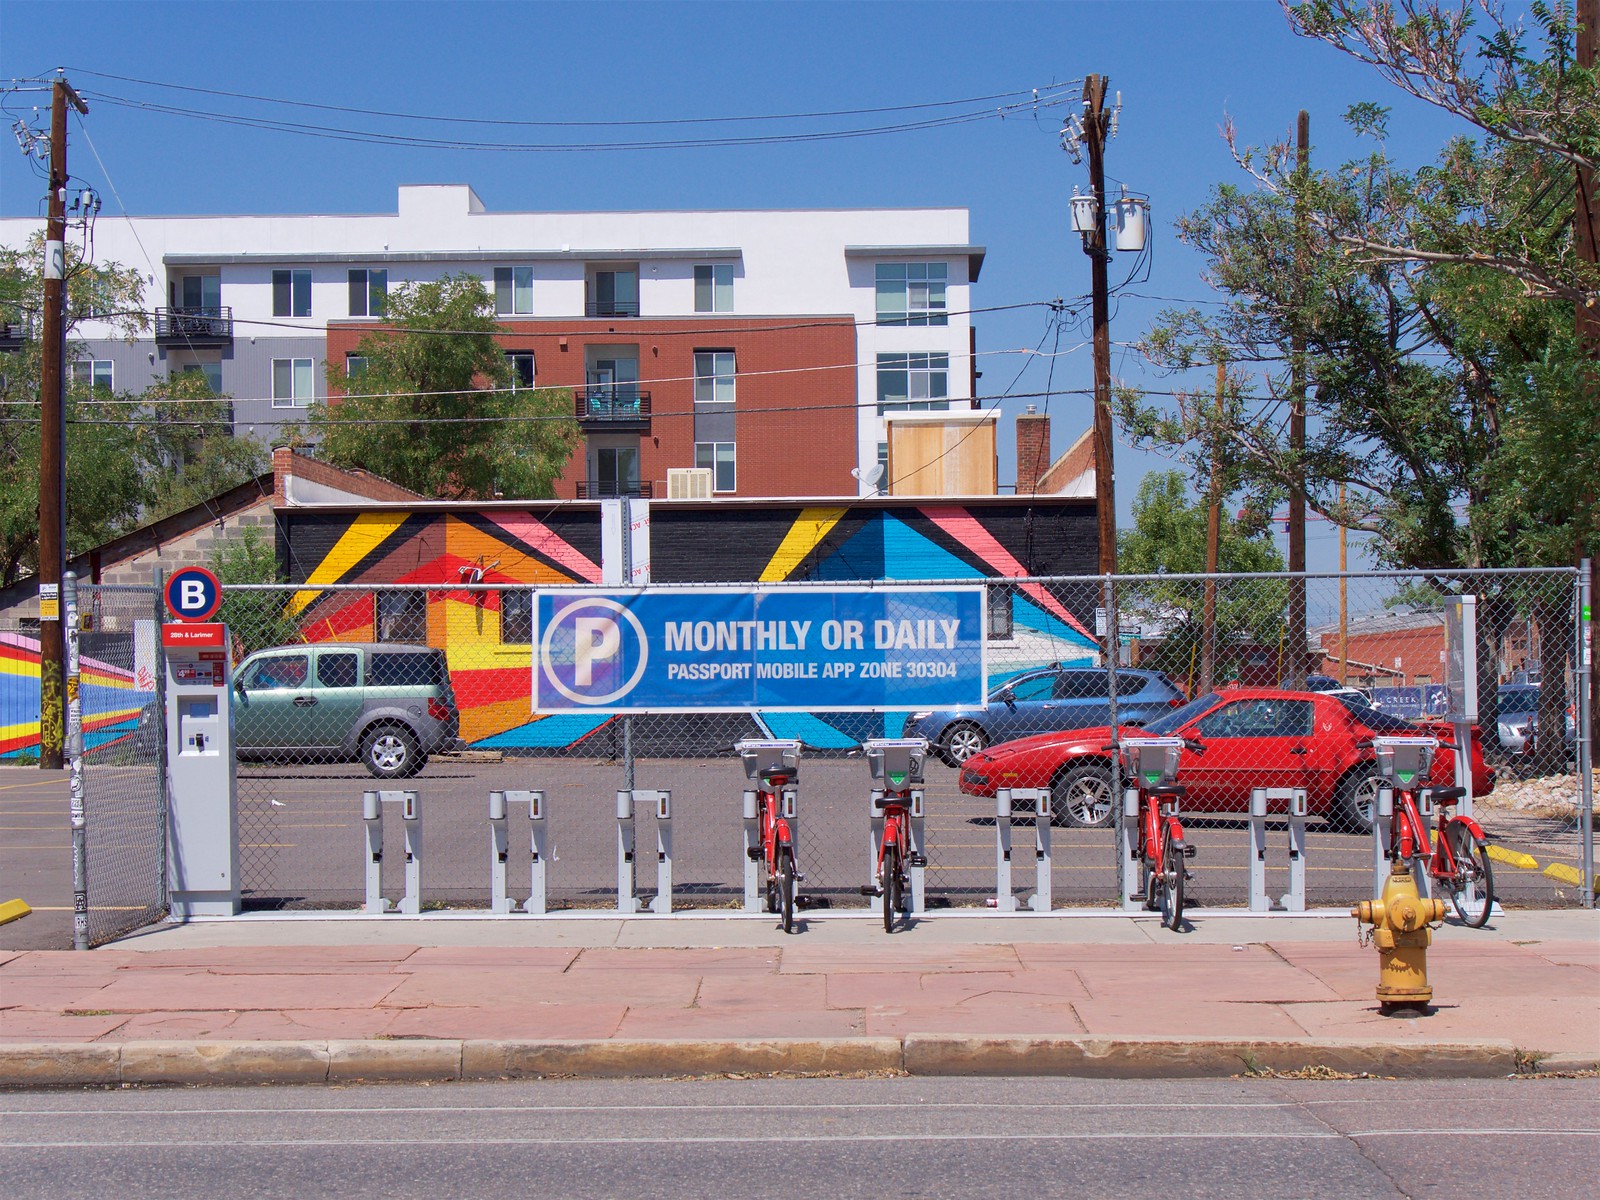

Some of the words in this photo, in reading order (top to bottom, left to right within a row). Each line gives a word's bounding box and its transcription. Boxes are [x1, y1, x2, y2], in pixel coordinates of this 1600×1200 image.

[181, 580, 206, 610] B
[190, 631, 214, 639] Larimer
[664, 620, 812, 652] MONTHLY
[821, 619, 864, 651] OR
[874, 619, 961, 650] DAILY
[575, 617, 621, 686] P
[667, 662, 752, 680] PASSPORT
[756, 662, 818, 680] MOBILE
[822, 662, 856, 679] APP
[859, 662, 902, 679] ZONE
[906, 661, 957, 679] 30304
[1386, 696, 1417, 704] CREEK
